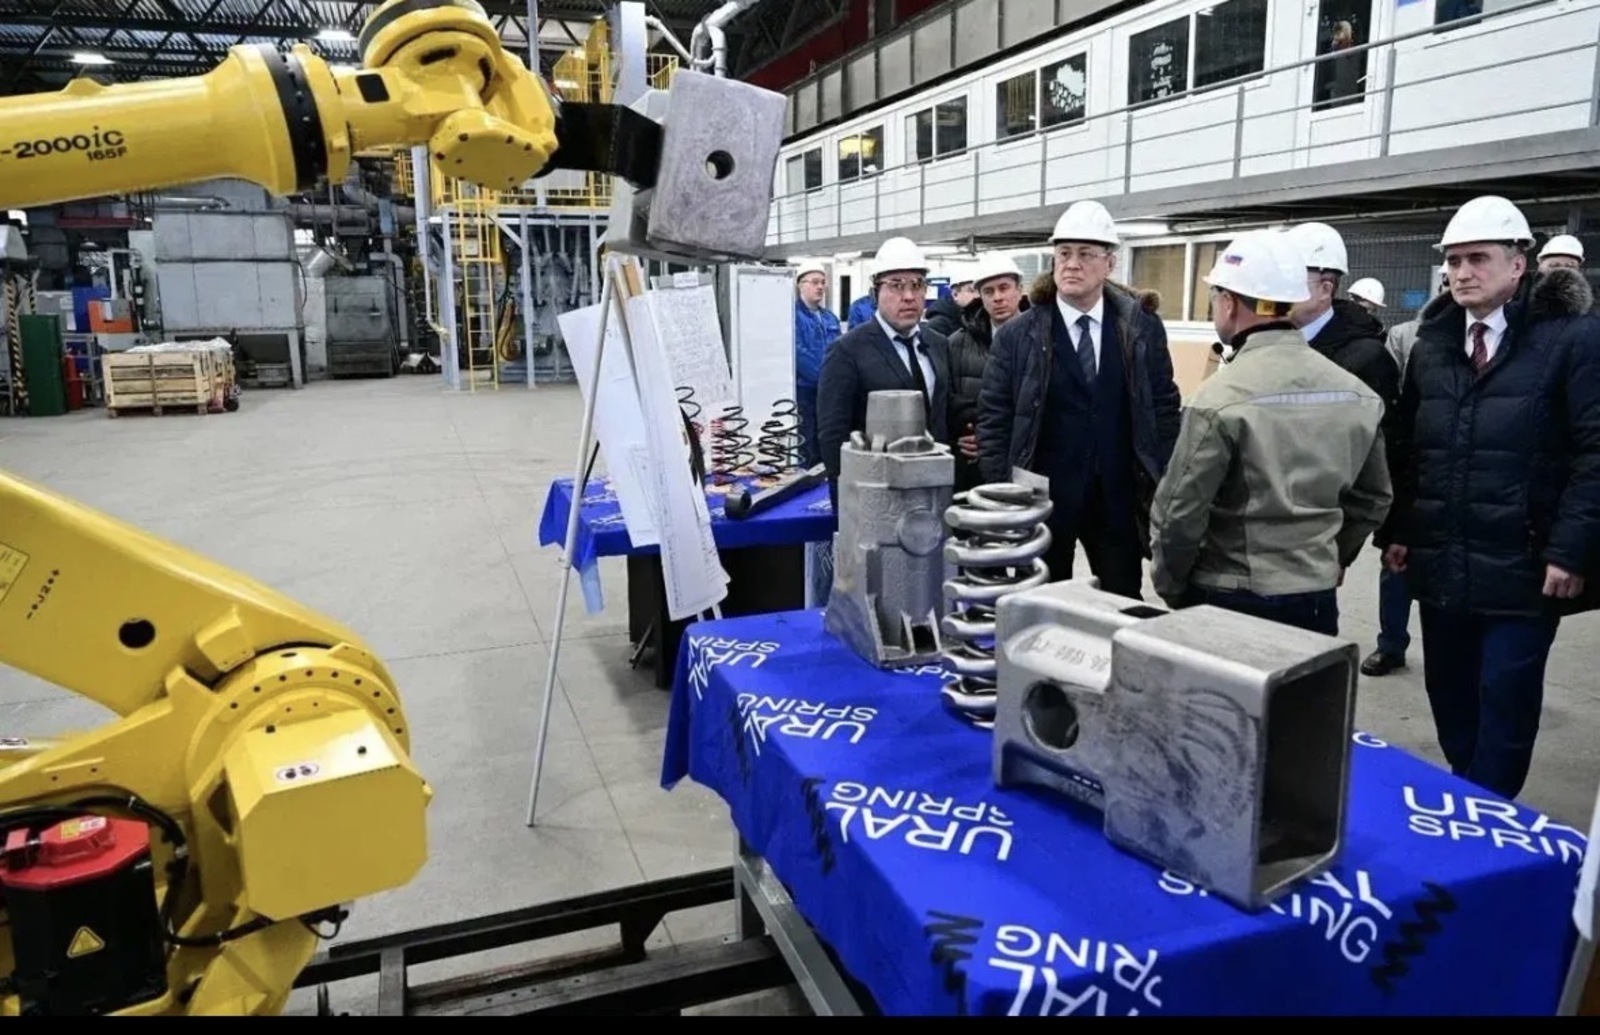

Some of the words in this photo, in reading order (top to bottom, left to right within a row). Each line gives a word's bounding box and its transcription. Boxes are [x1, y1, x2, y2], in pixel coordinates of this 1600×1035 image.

[0, 125, 124, 159] -2000iC
[86, 147, 127, 161] 165F
[825, 802, 1013, 861] URAL
